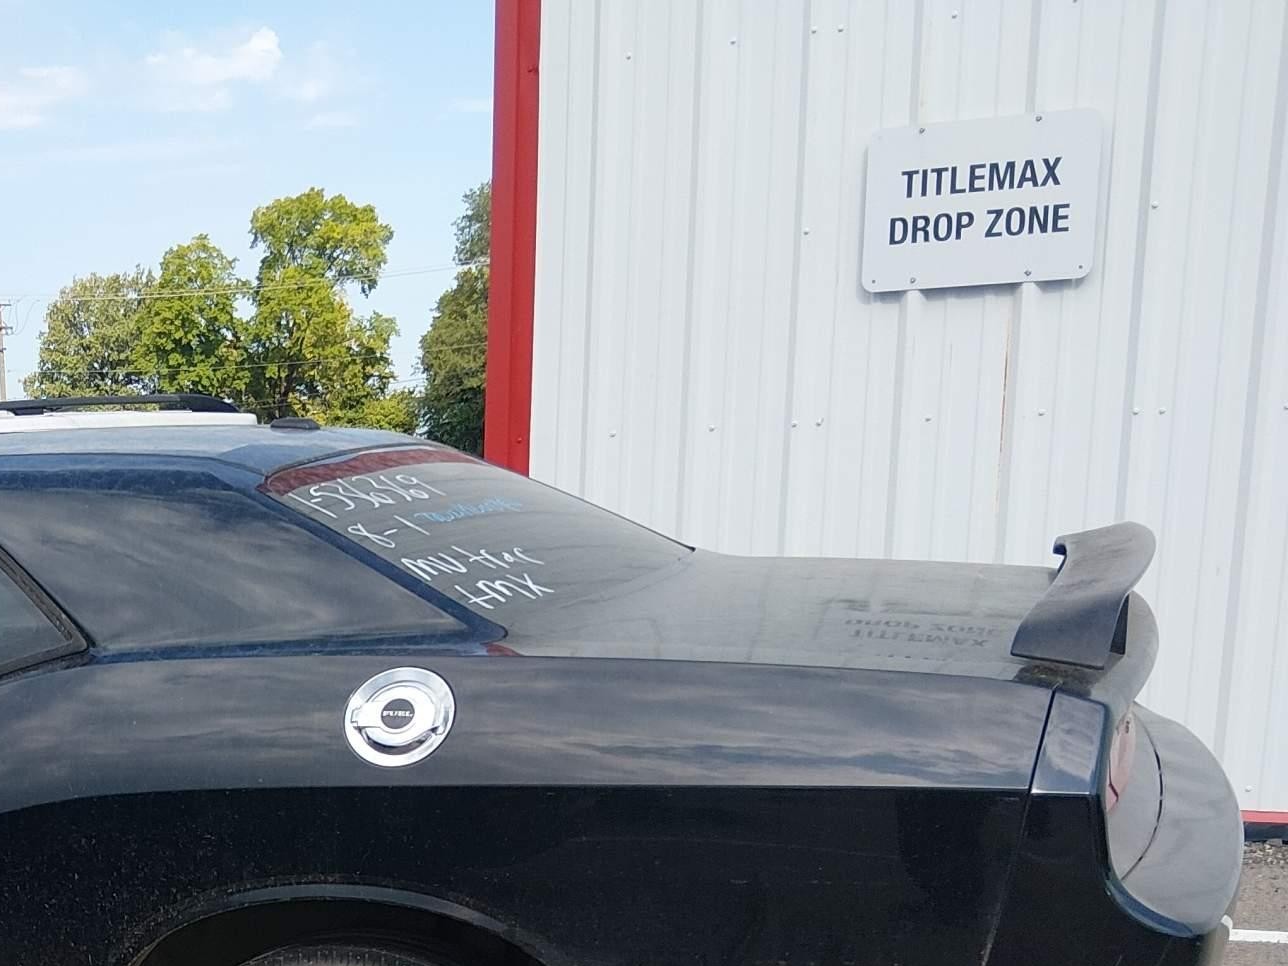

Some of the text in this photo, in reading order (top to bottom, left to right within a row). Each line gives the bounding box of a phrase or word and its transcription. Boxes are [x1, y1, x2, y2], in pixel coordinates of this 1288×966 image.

[902, 156, 1062, 199] TITLEMAX
[888, 203, 1071, 246] DROP ZONE
